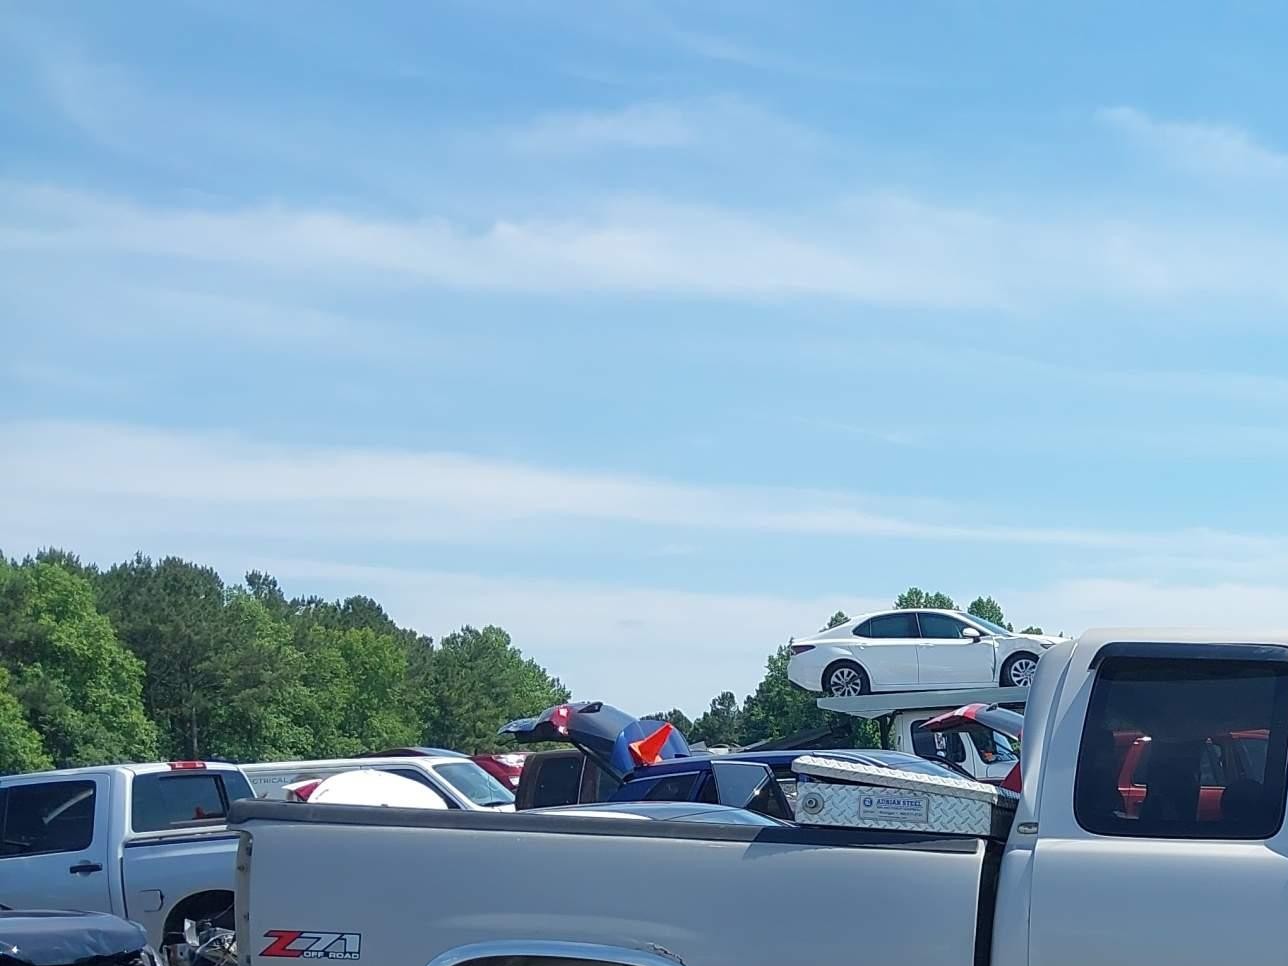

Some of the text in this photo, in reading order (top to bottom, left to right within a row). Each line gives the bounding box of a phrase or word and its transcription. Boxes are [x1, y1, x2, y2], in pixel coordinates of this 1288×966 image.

[876, 798, 922, 807] ADRIAN STEEL
[259, 929, 362, 958] Z71
[303, 951, 360, 960] OFF ROAD
